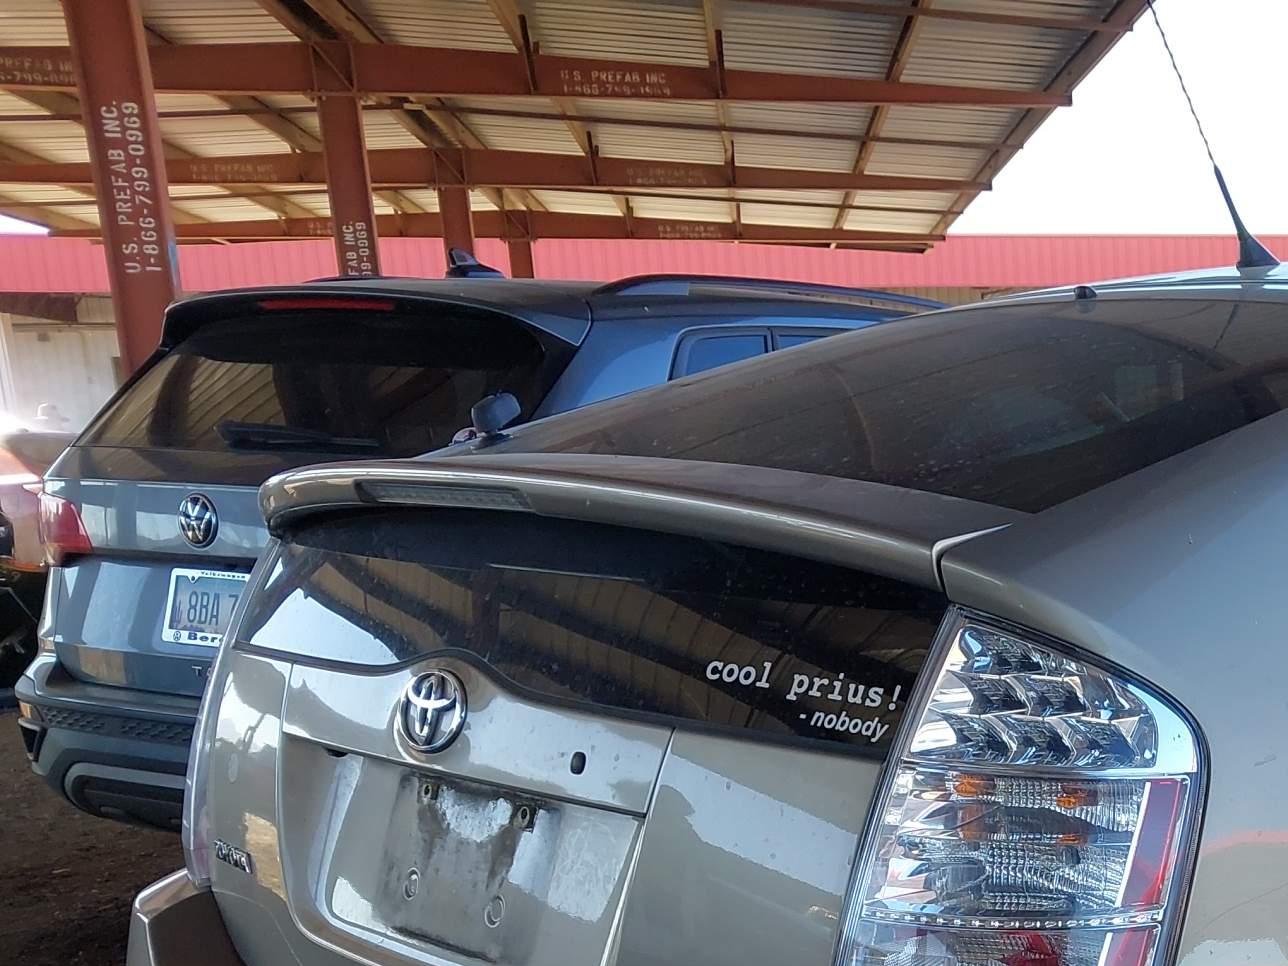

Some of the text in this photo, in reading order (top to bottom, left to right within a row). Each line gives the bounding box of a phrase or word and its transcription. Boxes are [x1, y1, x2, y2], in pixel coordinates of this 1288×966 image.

[100, 100, 142, 273] U.S. PREFAB INC.
[121, 102, 162, 272] 1-866-799-0969
[187, 590, 220, 626] 8BA
[705, 660, 902, 712] cool prius!
